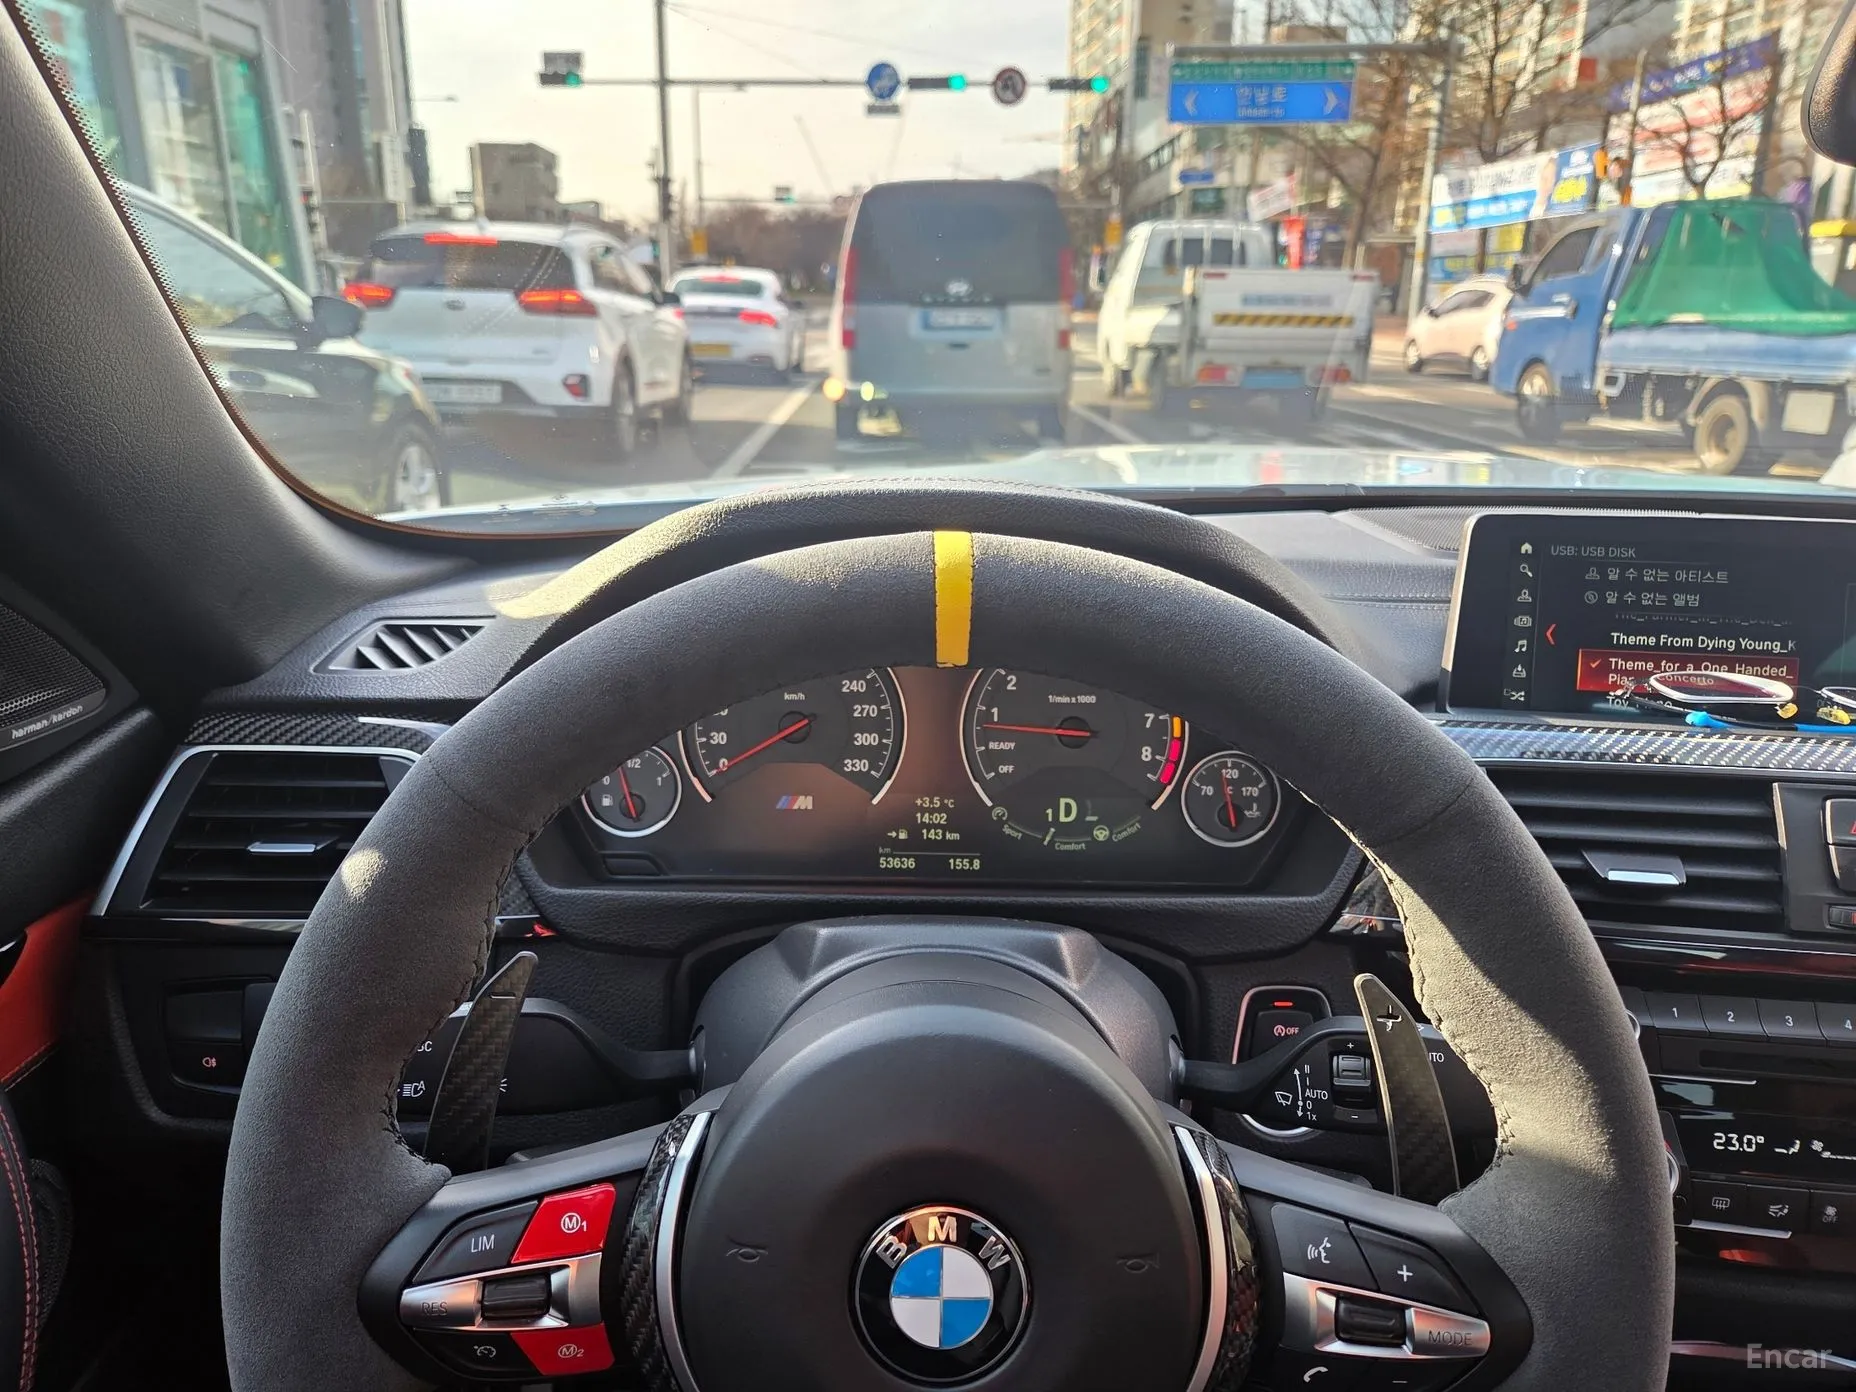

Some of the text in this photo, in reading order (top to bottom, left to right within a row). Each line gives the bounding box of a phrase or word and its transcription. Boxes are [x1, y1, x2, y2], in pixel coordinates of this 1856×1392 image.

[1551, 545, 1637, 558] USB: USB DISK
[1607, 567, 1729, 584] 알 수 없는 아티스트
[1605, 591, 1700, 607] 알 수 없는 앨범
[1610, 632, 1656, 647] Theme
[1660, 634, 1694, 648] From
[1698, 635, 1736, 651] Dying
[841, 680, 866, 692] 240
[1006, 675, 1017, 690] 2
[784, 692, 805, 701] km/h
[1048, 695, 1070, 703] 1/min
[1077, 695, 1096, 704] 1000
[853, 705, 878, 717] 270
[991, 707, 999, 722] 1
[1144, 713, 1155, 728] 7
[710, 732, 727, 745] 30
[854, 733, 879, 746] 300
[988, 742, 1016, 750] READY
[1141, 746, 1152, 761] 8
[719, 758, 728, 771] 0
[843, 759, 869, 772] 330
[999, 765, 1015, 774] OFF
[1221, 769, 1239, 779] 120
[602, 775, 611, 786] 0
[656, 777, 662, 786] 1
[1200, 786, 1214, 796] 70
[1241, 787, 1259, 798] 170
[915, 797, 940, 808] +3.5
[1046, 797, 1078, 823] 1 D
[916, 813, 947, 824] 14:02
[922, 829, 960, 840] 143 km
[1002, 824, 1023, 840] Sport
[1112, 822, 1141, 842] Comfort
[879, 846, 891, 854] km
[1055, 842, 1086, 850] Comfort
[880, 857, 980, 870] 53636 155.8
[1672, 1007, 1678, 1018] 1
[1727, 1011, 1735, 1022] 2
[1785, 1015, 1794, 1027] 3
[1844, 1019, 1853, 1031] 4
[1305, 1090, 1328, 1100] AUTO
[1306, 1111, 1317, 1121] 1x
[1822, 1215, 1838, 1223] OFF
[471, 1234, 495, 1253] LIM
[876, 1215, 1012, 1270] BMW
[421, 1301, 448, 1316] RES
[1428, 1330, 1472, 1346] MODE
